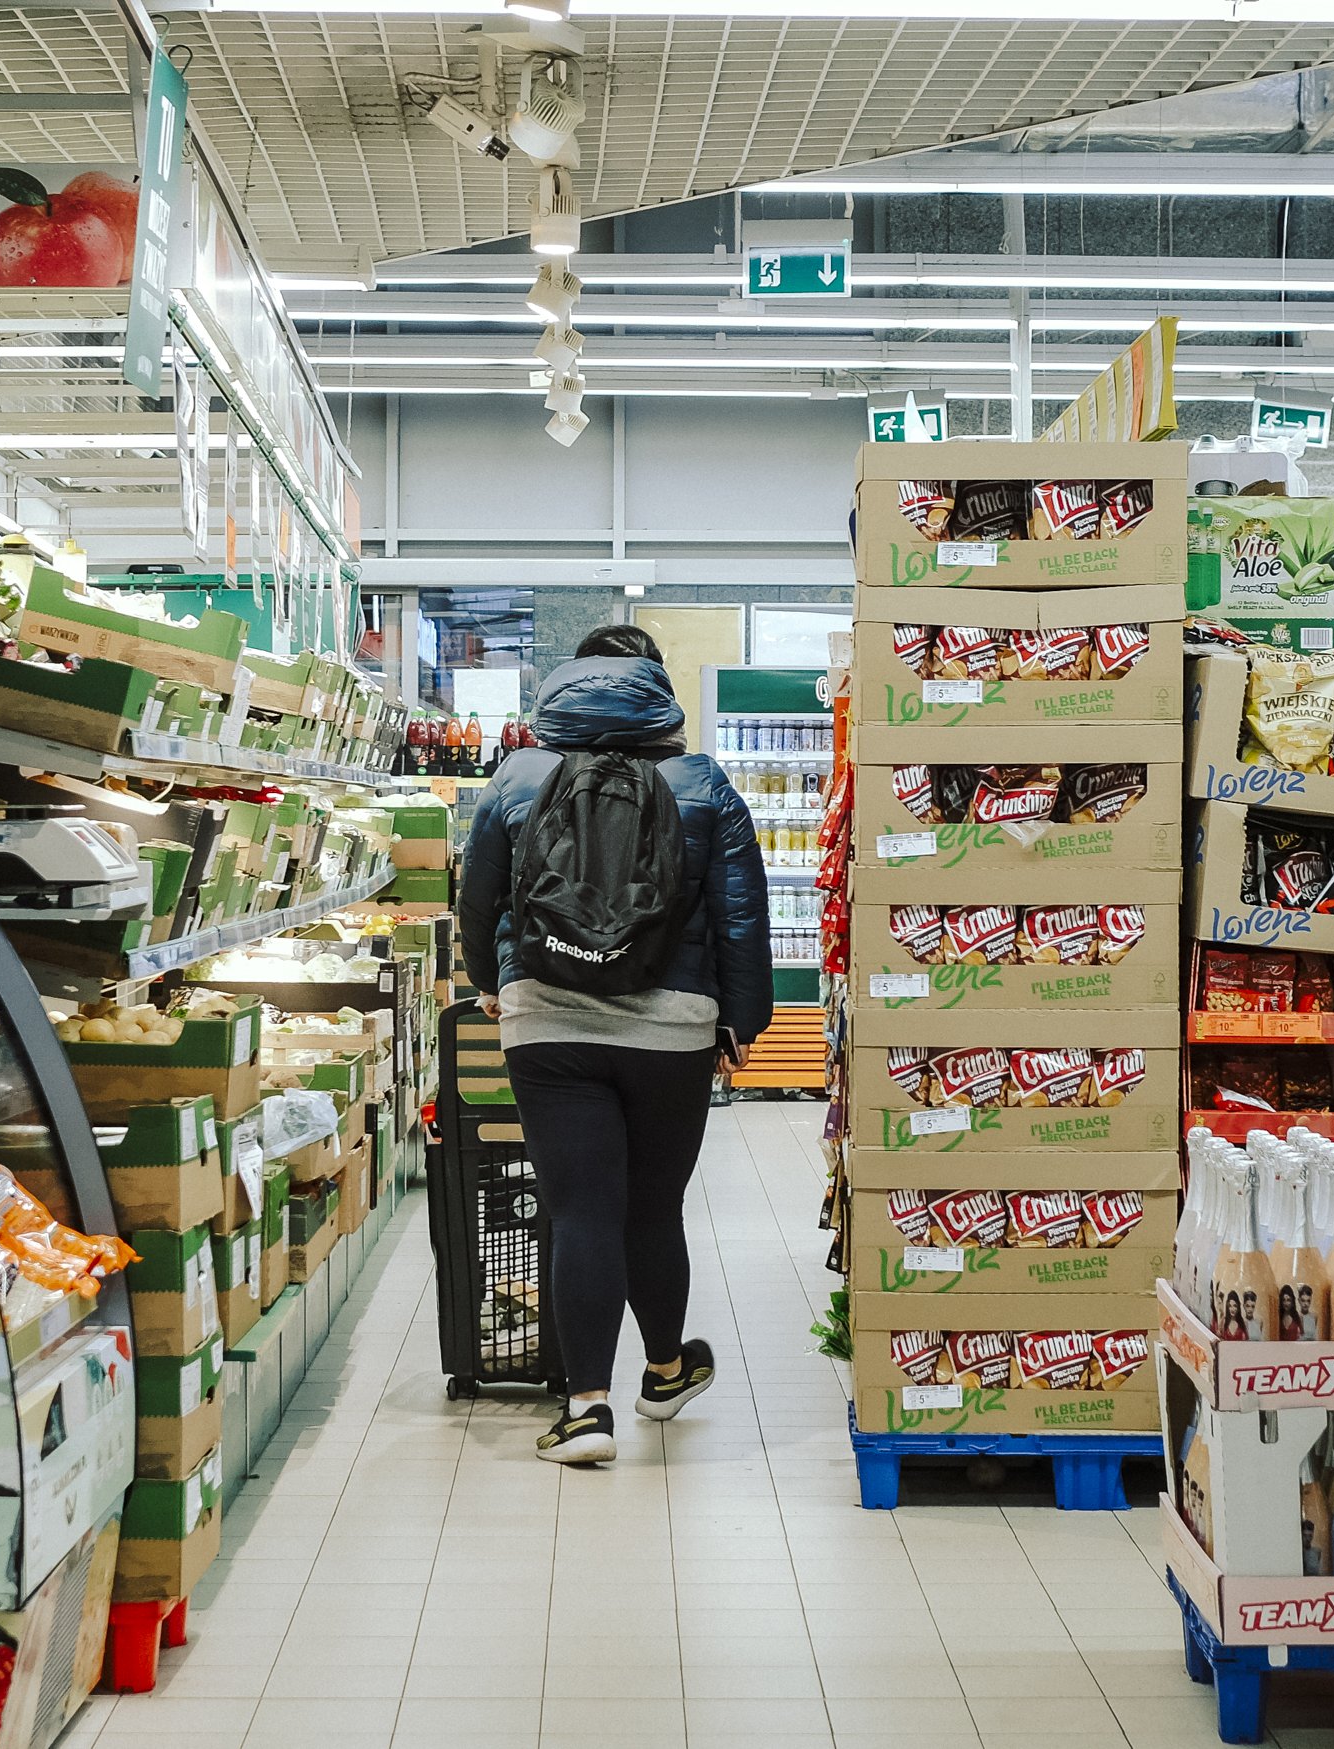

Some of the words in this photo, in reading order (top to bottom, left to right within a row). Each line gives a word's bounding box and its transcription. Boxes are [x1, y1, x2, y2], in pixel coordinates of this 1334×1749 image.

[1233, 537, 1278, 558] Vita
[1038, 558, 1061, 570] I'LL
[1064, 554, 1081, 567] BE
[1083, 547, 1118, 563] BACK
[1049, 562, 1117, 576] #RECYCLABLE
[1233, 556, 1283, 578] Aloe
[1290, 592, 1329, 605] original
[1035, 699, 1058, 711] I'LL
[1059, 696, 1076, 708] BE
[1079, 690, 1115, 704] BACK
[1045, 704, 1114, 717] #RECYCLABLE
[1265, 709, 1334, 722] ZIEMNIACZKI
[1207, 763, 1307, 804] Lorenz
[979, 791, 1054, 822] Crunchips
[1034, 840, 1056, 852] I'LL
[1059, 836, 1076, 849] BE
[1077, 830, 1113, 845] BACK
[1043, 844, 1112, 858] #RECYCLABLE
[1212, 906, 1312, 948] Lorenz
[544, 933, 604, 965] Reebok
[1031, 982, 1054, 995] I'LL
[1057, 979, 1073, 991] BE
[1076, 973, 1111, 988] BACK
[1041, 987, 1110, 1001] #RECYCLABLE
[1031, 1124, 1054, 1136] I'LL
[1055, 1121, 1072, 1133] BE
[1075, 1115, 1111, 1130] BACK
[1040, 1129, 1109, 1142] #RECYCLABLE
[1028, 1264, 1051, 1276] I'LL
[1053, 1260, 1070, 1273] BE
[1073, 1255, 1108, 1270] BACK
[1038, 1270, 1107, 1283] #RECYCLABLE
[1035, 1407, 1057, 1419] I'LL
[1060, 1403, 1076, 1415] BE
[1079, 1398, 1114, 1412] BACK
[1044, 1412, 1113, 1425] #RECYCLABLE
